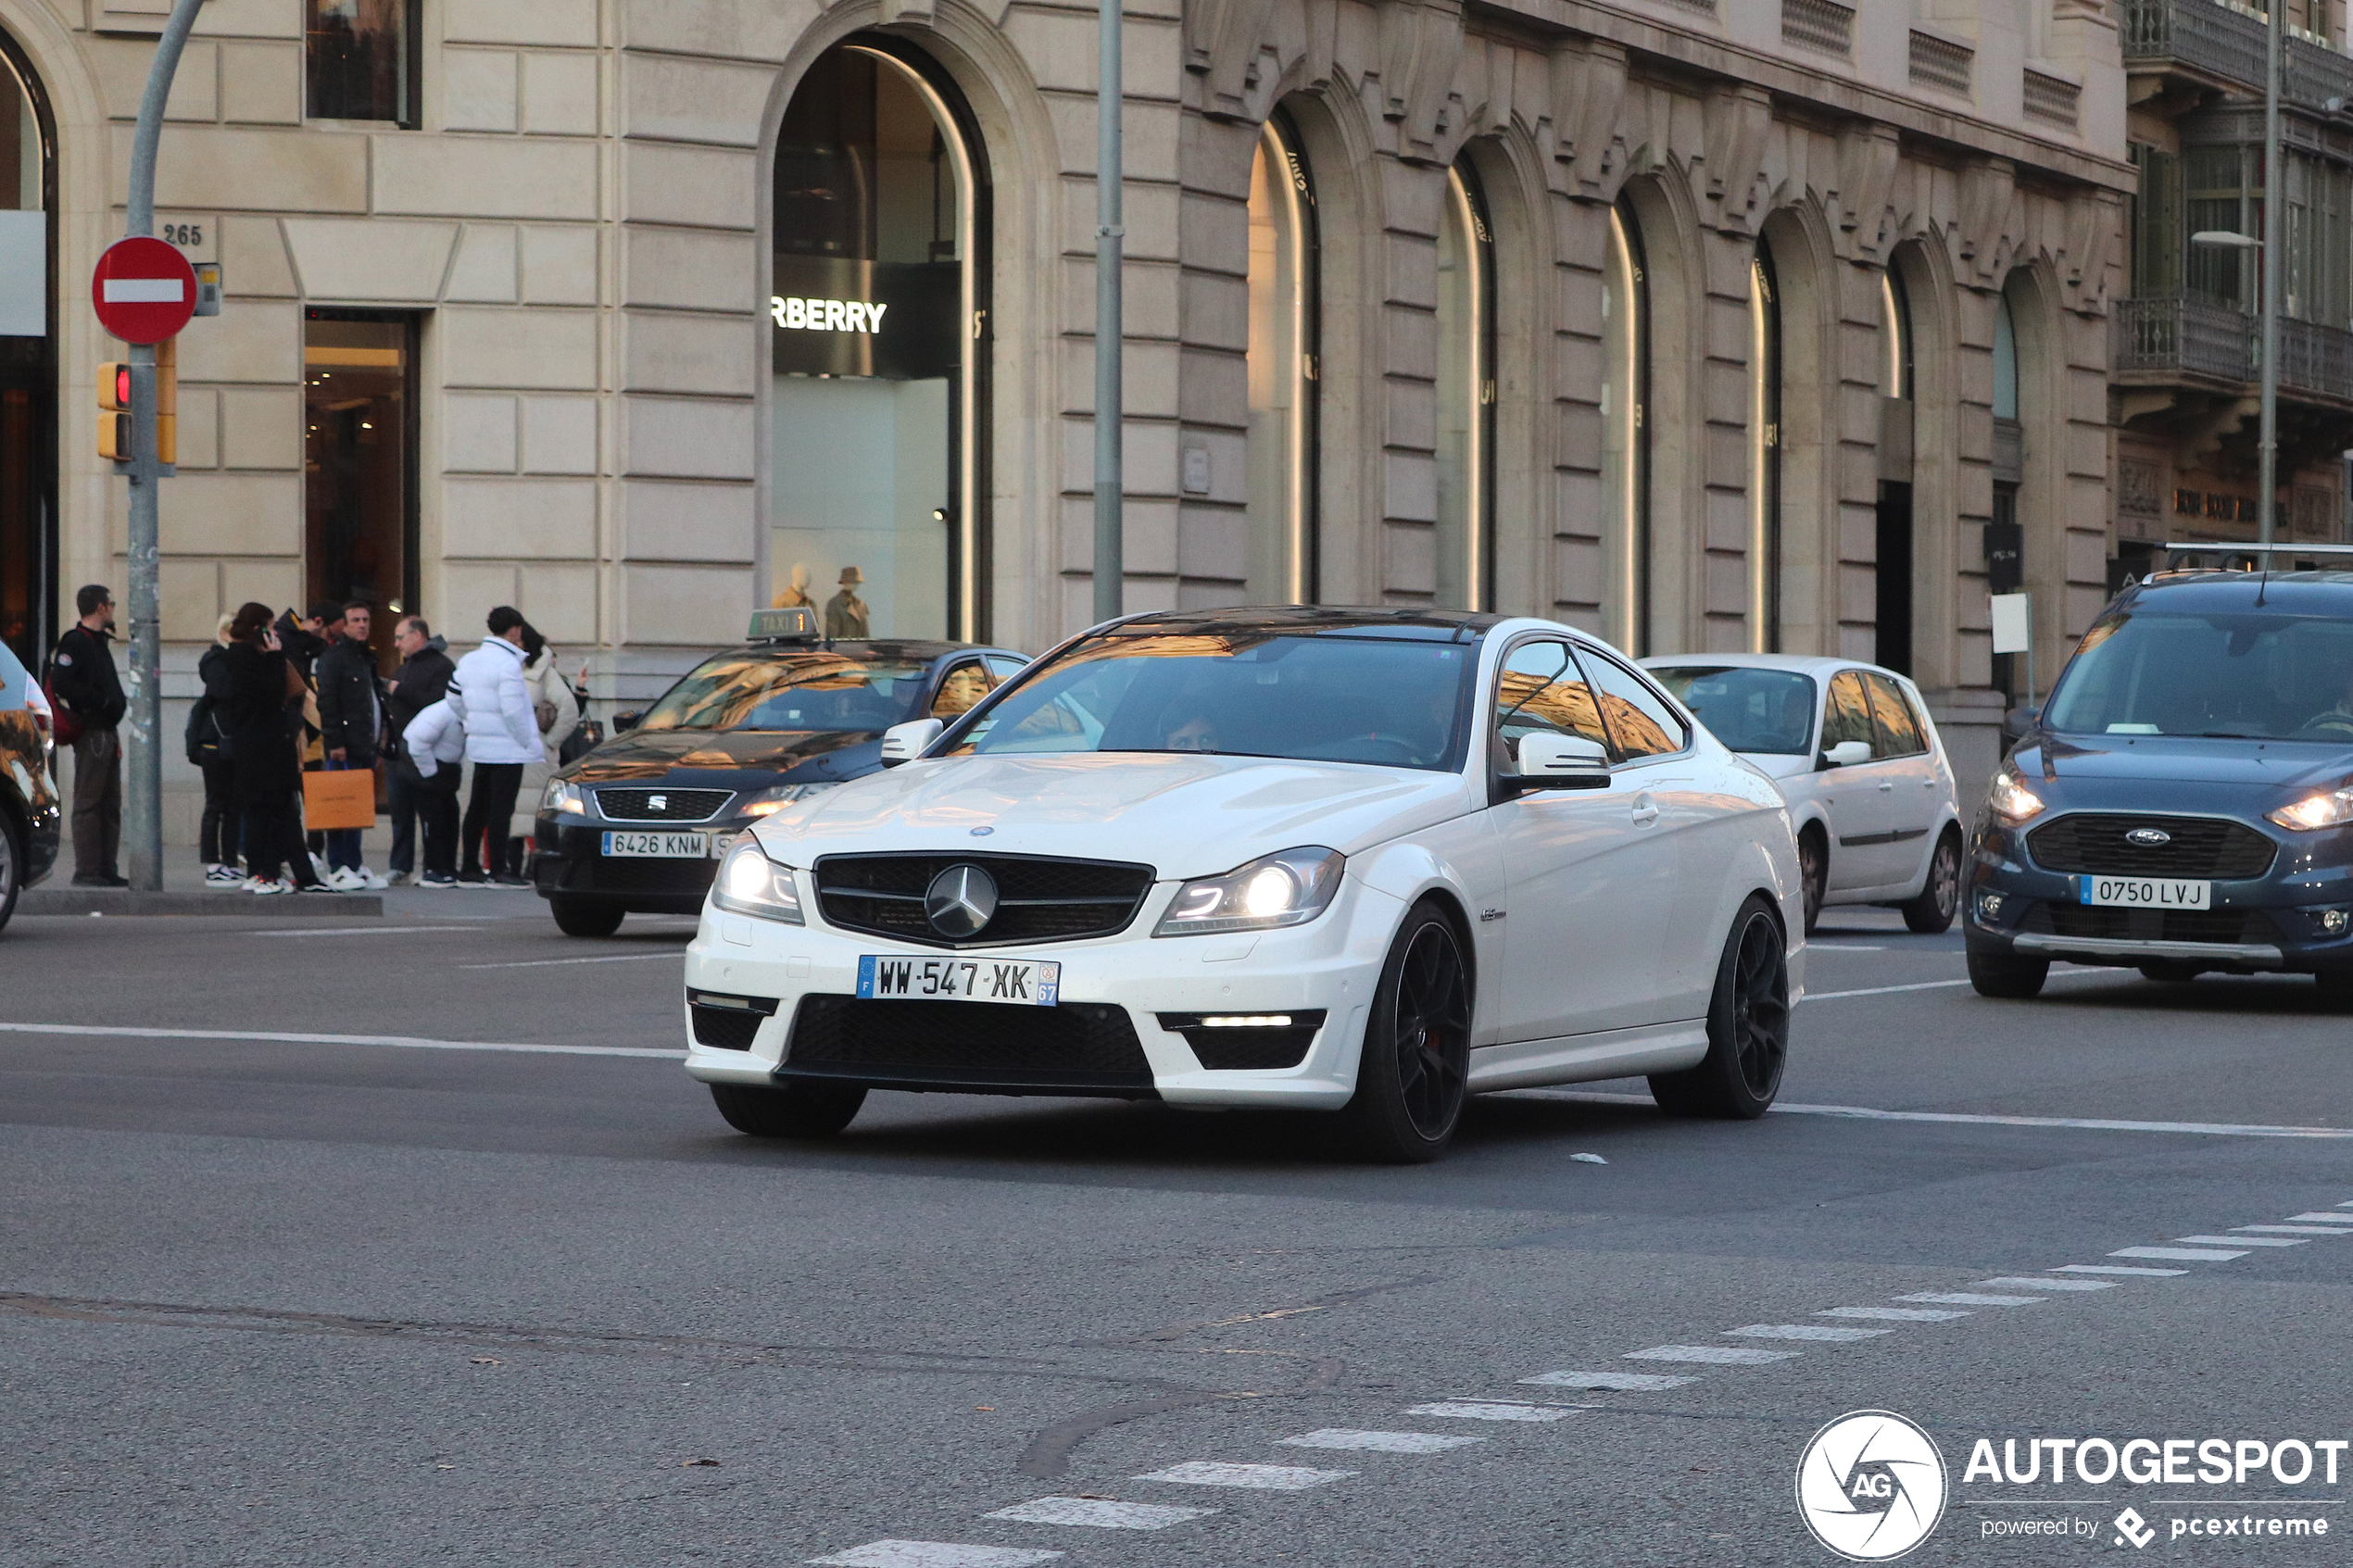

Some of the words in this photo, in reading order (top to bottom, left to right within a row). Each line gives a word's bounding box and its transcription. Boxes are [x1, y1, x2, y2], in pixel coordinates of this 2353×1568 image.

[164, 224, 201, 245] 265
[615, 835, 659, 852] 6426
[666, 836, 701, 854] KNM
[2100, 881, 2153, 902] 0750
[2161, 884, 2201, 904] LVJ
[862, 982, 868, 991] F
[1038, 985, 1056, 1001] 67
